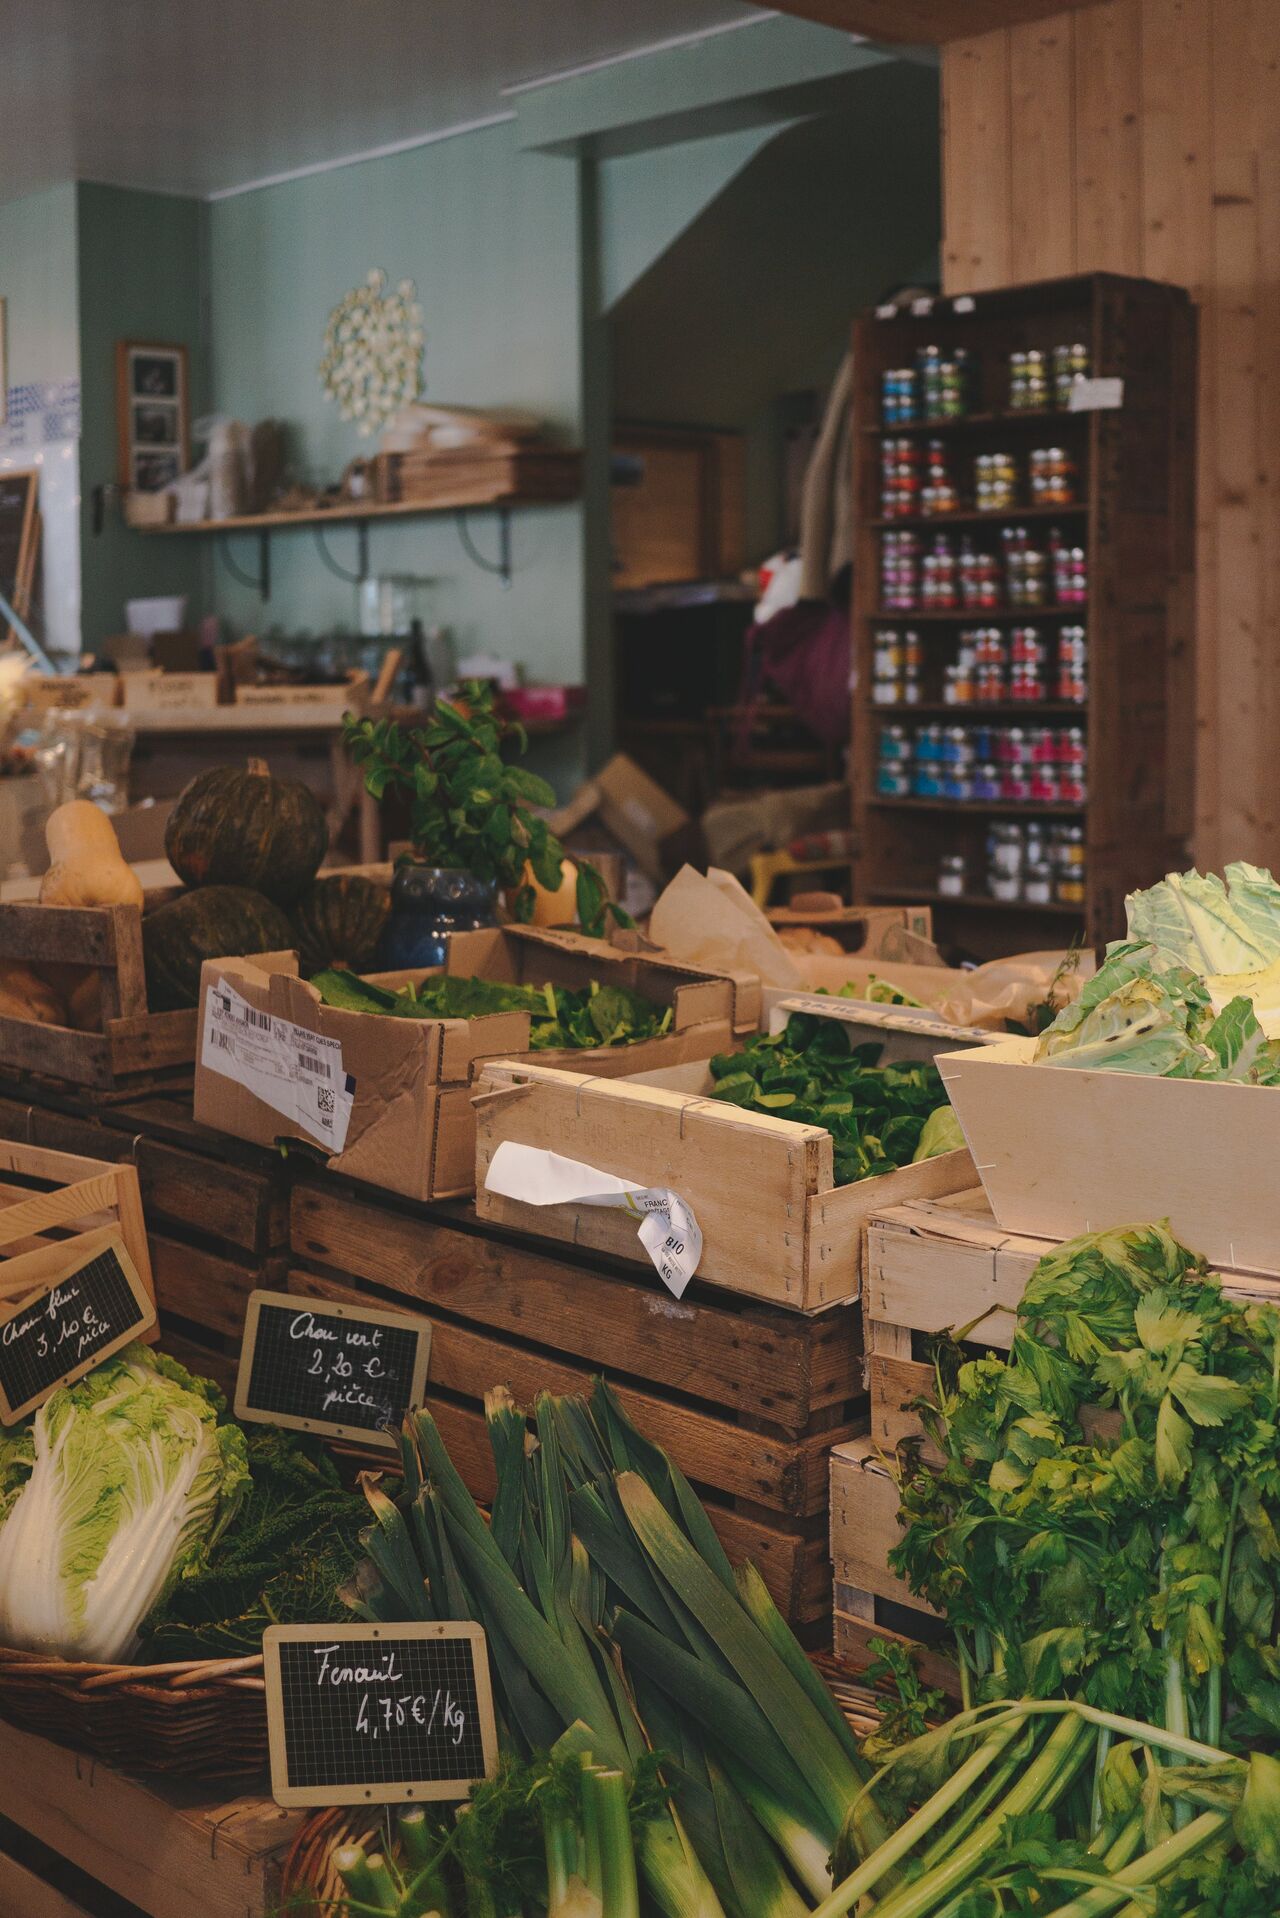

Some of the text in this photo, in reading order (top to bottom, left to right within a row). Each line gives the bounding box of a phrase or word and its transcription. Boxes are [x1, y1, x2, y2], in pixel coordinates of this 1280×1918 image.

[644, 1199, 668, 1208] FRANC
[665, 1236, 685, 1255] BIO
[661, 1263, 673, 1280] KG
[290, 1312, 383, 1348] Chou vert
[307, 1348, 386, 1383] 2,20 €
